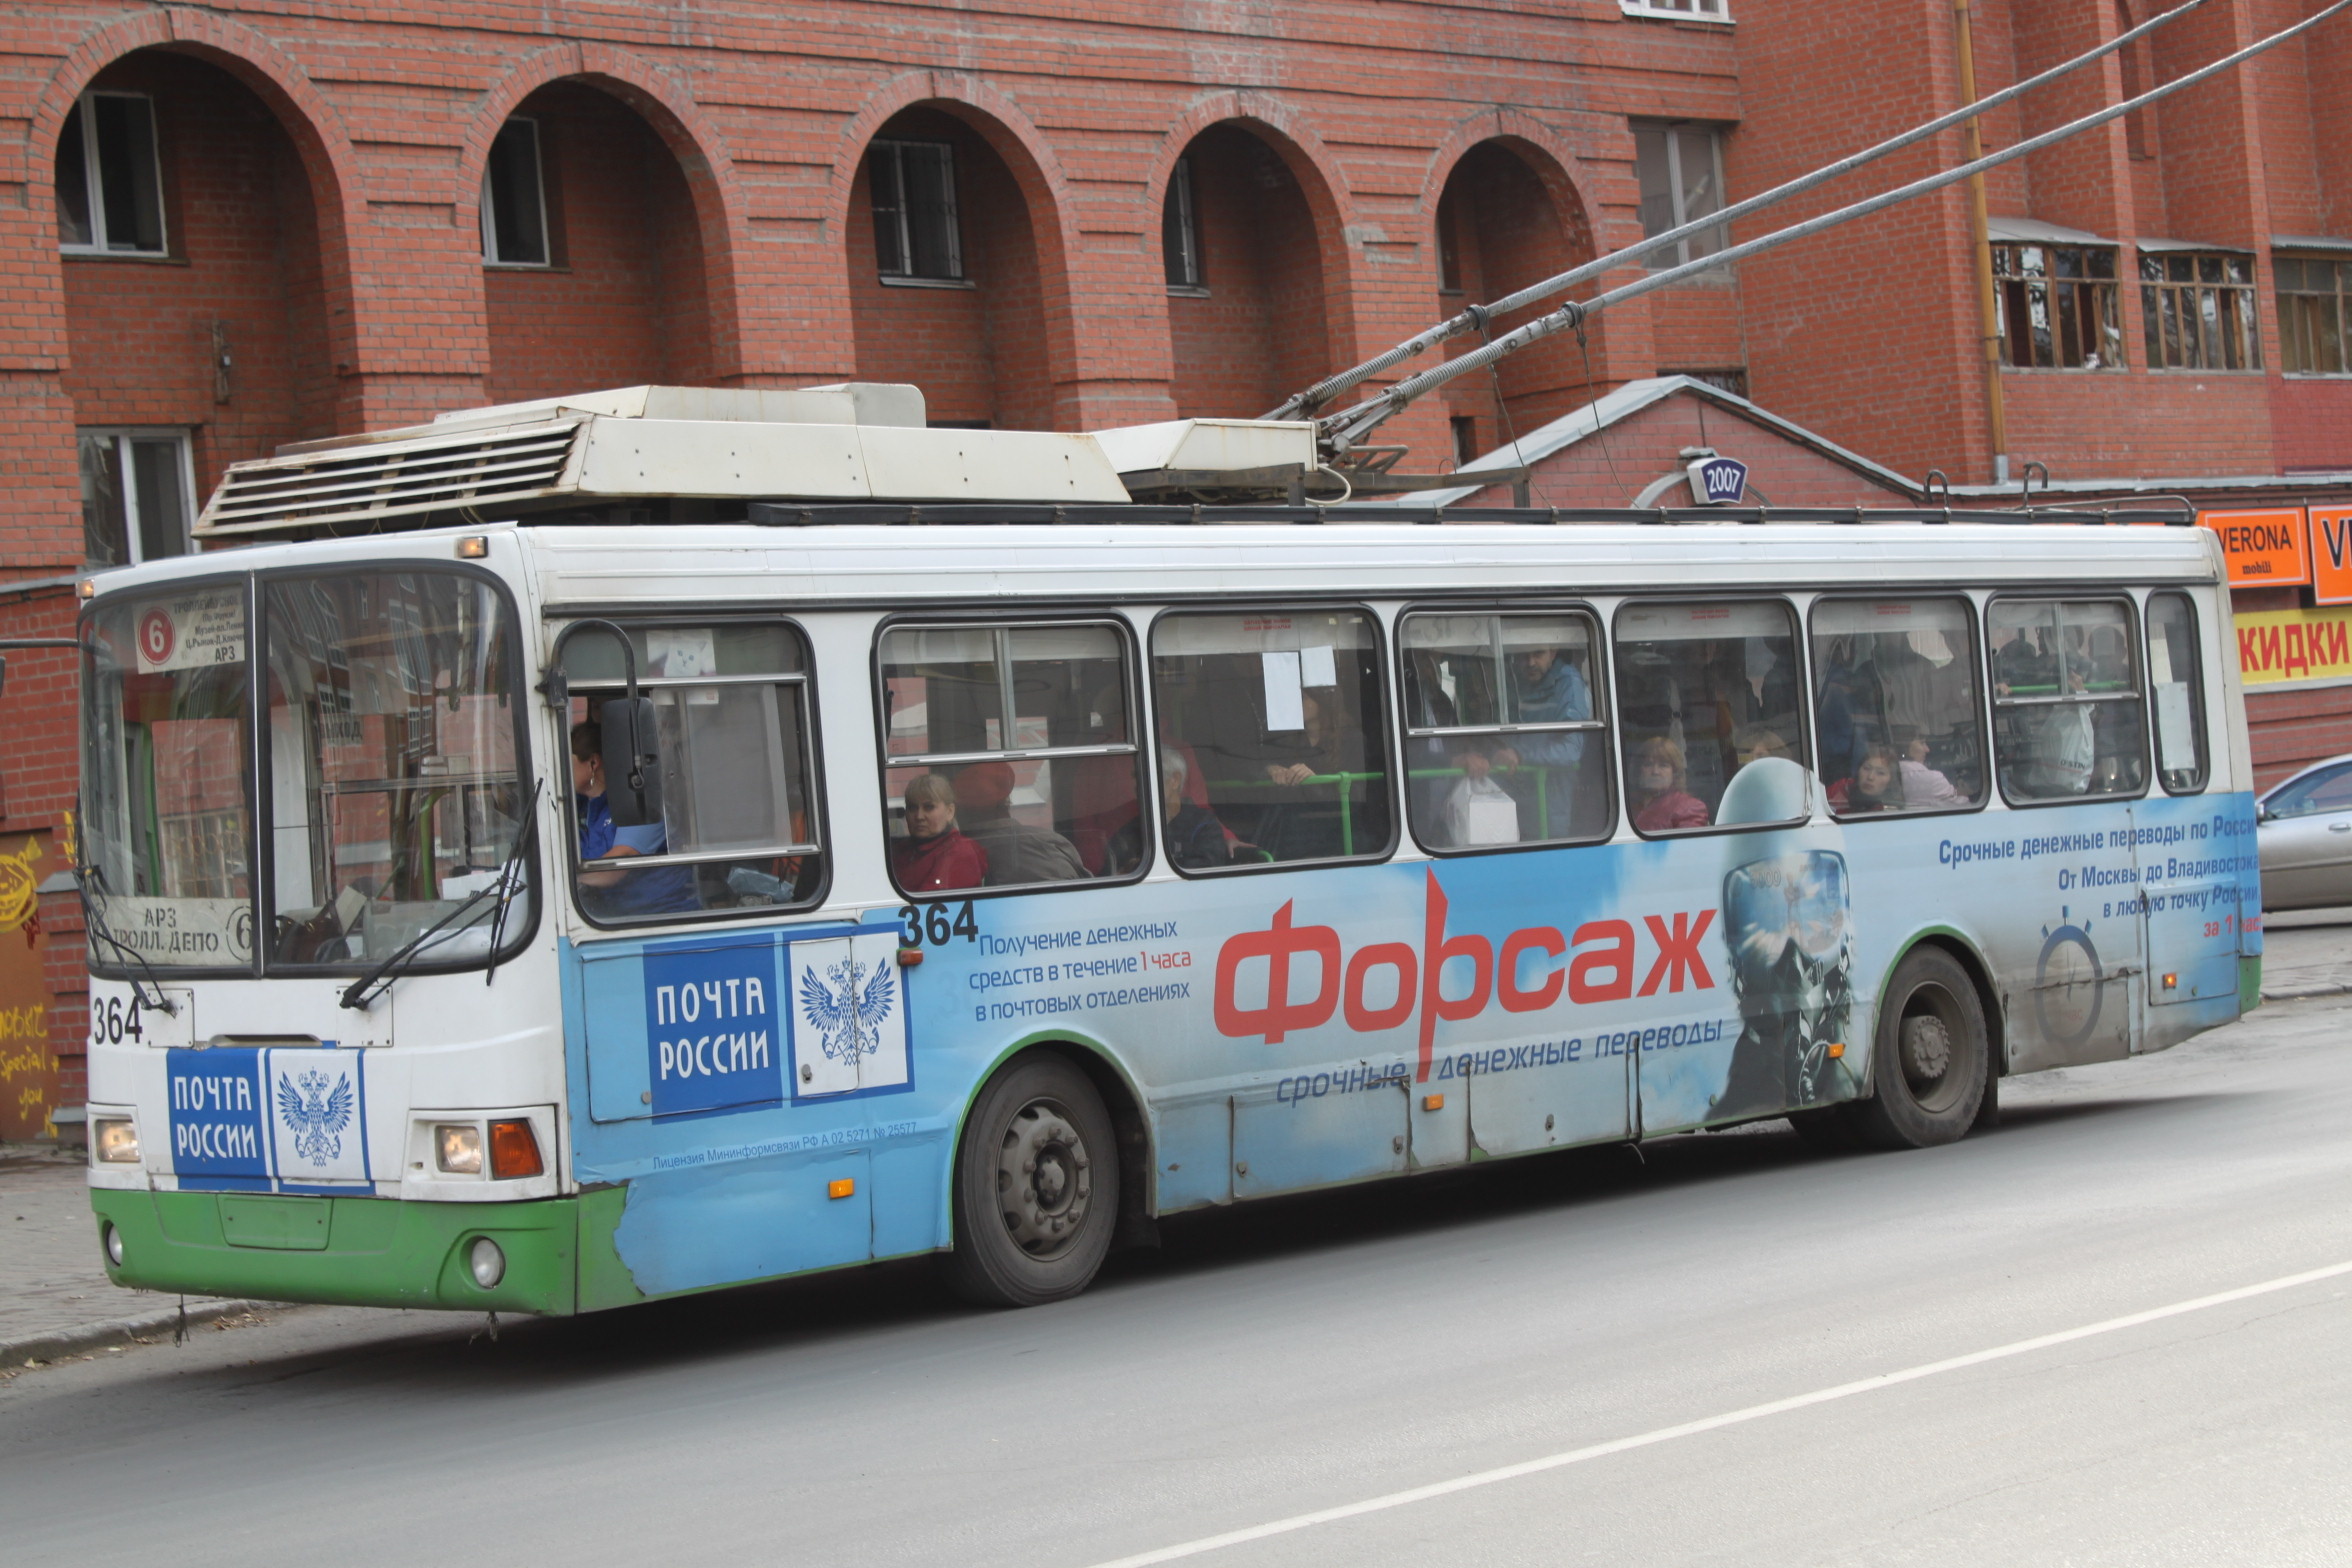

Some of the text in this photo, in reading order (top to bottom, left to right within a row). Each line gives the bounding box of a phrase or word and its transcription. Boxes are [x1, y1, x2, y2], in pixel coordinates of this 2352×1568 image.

[1707, 466, 1741, 493] 2007
[2215, 525, 2293, 553] VERONA
[2242, 561, 2272, 575] mobili
[148, 618, 165, 653] 6
[215, 646, 235, 662] АРЗ
[1939, 838, 2015, 869] Срочные
[2021, 830, 2104, 860] денежные
[2109, 823, 2185, 852] переводы
[2190, 820, 2208, 840] по
[2058, 868, 2077, 891] От
[2081, 862, 2141, 889] Москвы
[2145, 860, 2163, 885] до
[144, 907, 177, 929] АРЗ
[898, 899, 979, 949] 364
[2103, 901, 2112, 919] в
[2116, 894, 2166, 922] любую
[2170, 890, 2209, 913] точку
[169, 930, 219, 954] ДЕПО
[236, 912, 252, 950] 6
[980, 920, 1178, 957] Получение денежных
[2203, 920, 2220, 938] за
[2225, 913, 2234, 935] 1
[969, 950, 1192, 994] средств в течение 1 часа
[1213, 863, 1718, 1084] Форсаж
[656, 976, 766, 1026] ПОЧТА
[975, 982, 1191, 1022] в почтовых отделениях
[93, 995, 143, 1045] 364
[659, 1028, 769, 1081] РОССИИ
[1276, 1019, 1723, 1109] срочные денежные переводы
[174, 1075, 252, 1111] ПОЧТА
[176, 1122, 257, 1159] РОССИИ
[653, 1121, 918, 1170] Лицензия Мининформсвязи РФ А 02 5271 № 25577
